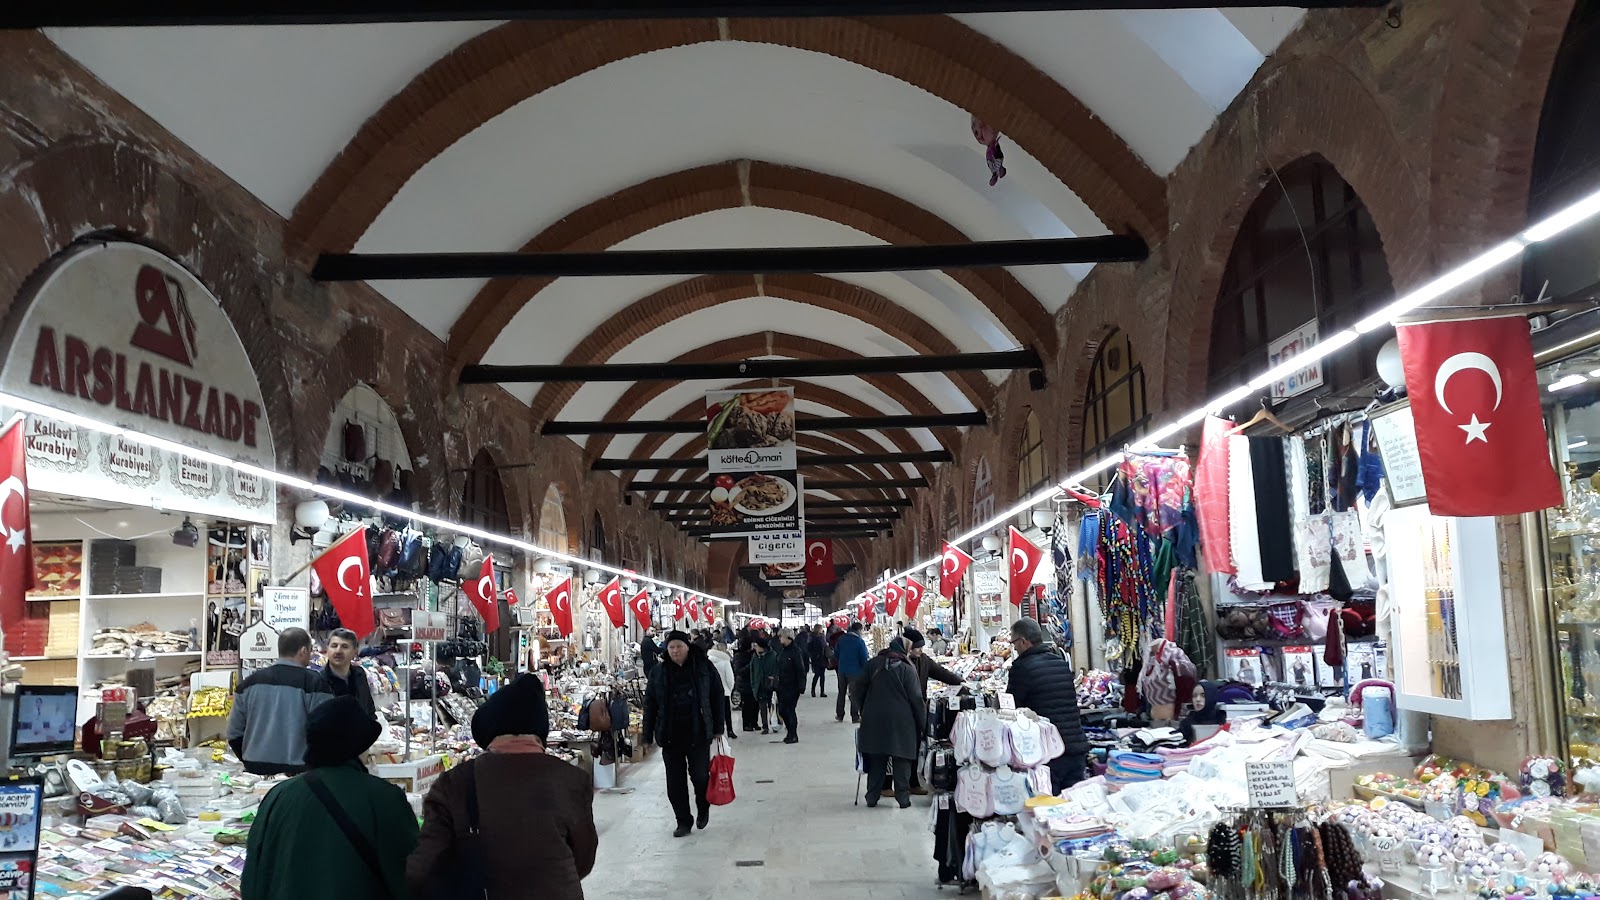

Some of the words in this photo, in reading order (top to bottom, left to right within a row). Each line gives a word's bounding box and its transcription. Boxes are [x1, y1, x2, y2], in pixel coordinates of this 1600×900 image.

[1289, 366, 1318, 389] GİYİM
[30, 325, 261, 448] ARSLANZADE
[34, 420, 72, 440] Kallavi
[28, 436, 77, 460] Kurabiye
[118, 438, 144, 457] Kavala
[110, 452, 151, 474] Kurabiyesi
[182, 454, 208, 471] Badem
[181, 468, 208, 484] Ezmesi
[240, 481, 256, 494] Misk
[754, 521, 784, 529] DENEDİNİZ
[765, 514, 795, 522] CİĞERİMİZİ
[1378, 841, 1389, 850] 40
[0, 870, 24, 879] CAYİP
